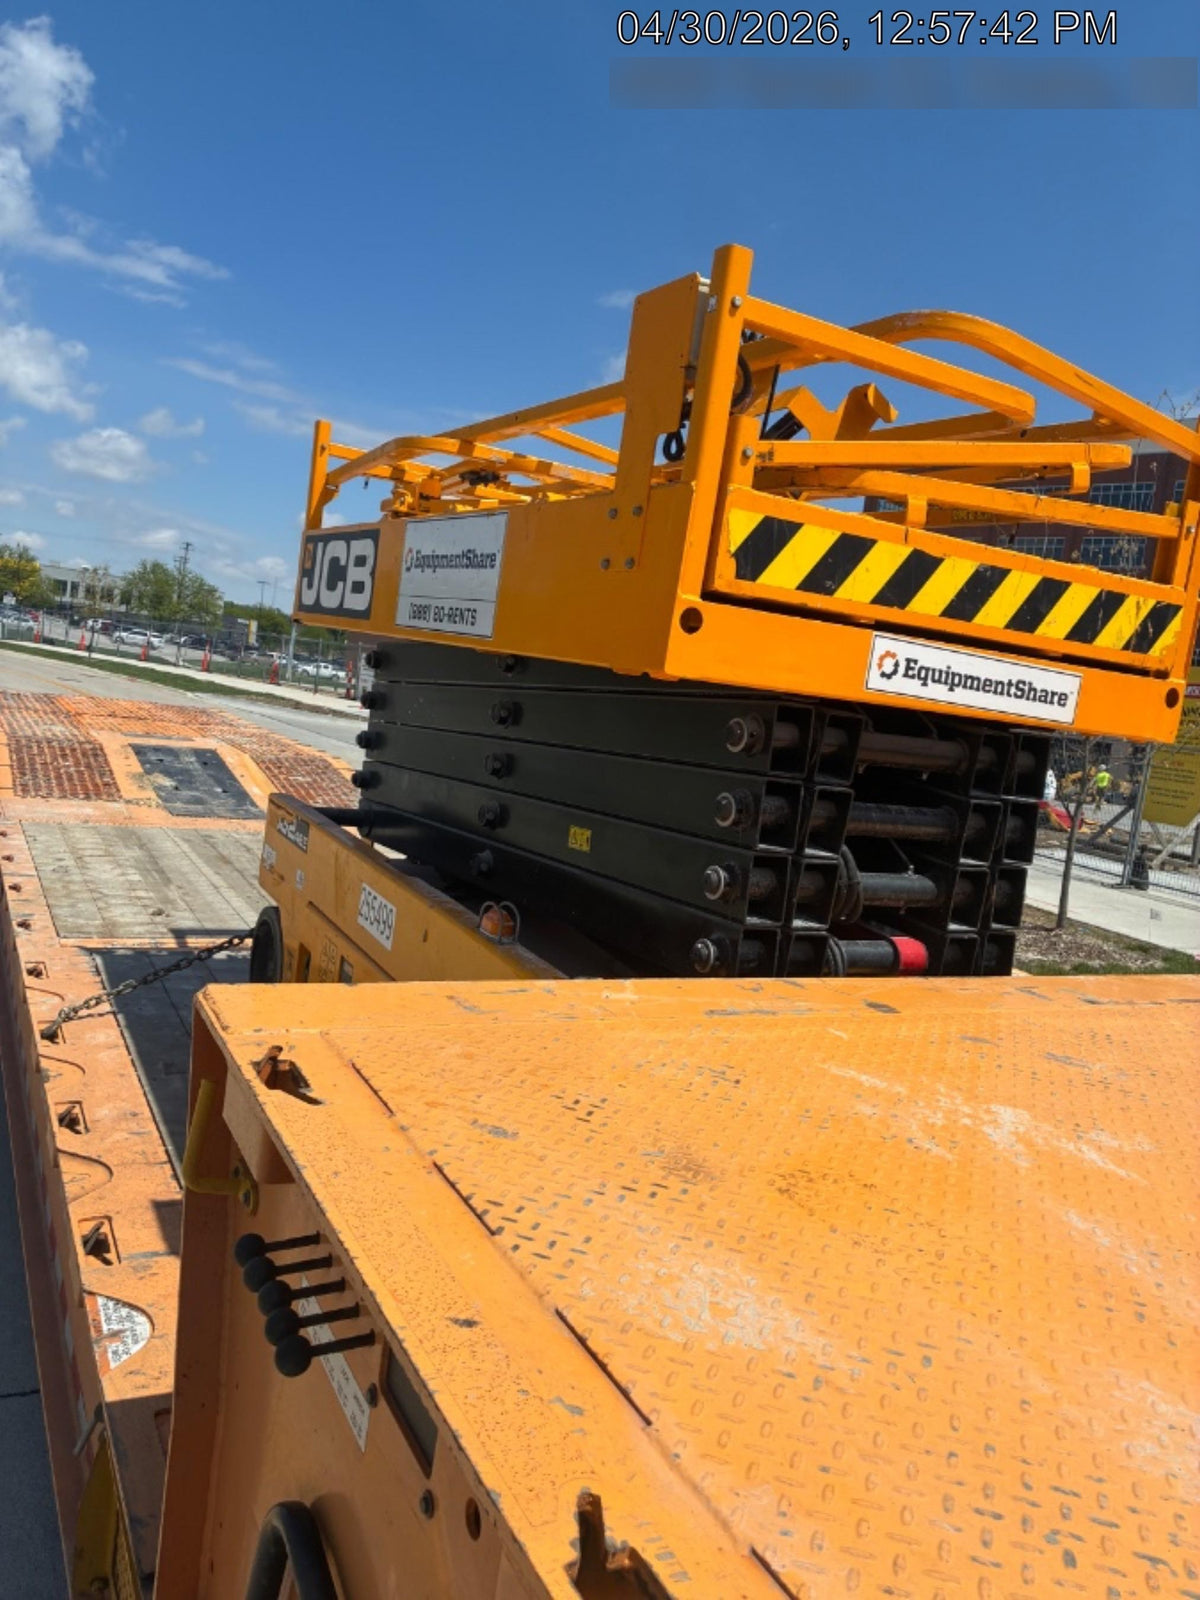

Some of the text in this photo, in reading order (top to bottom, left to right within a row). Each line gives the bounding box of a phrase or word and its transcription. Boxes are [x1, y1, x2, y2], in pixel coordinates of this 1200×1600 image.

[302, 538, 376, 611] JCB
[413, 549, 497, 574] EquipmentShare
[902, 657, 1069, 708] EquipmentShare
[358, 886, 393, 941] 255499
